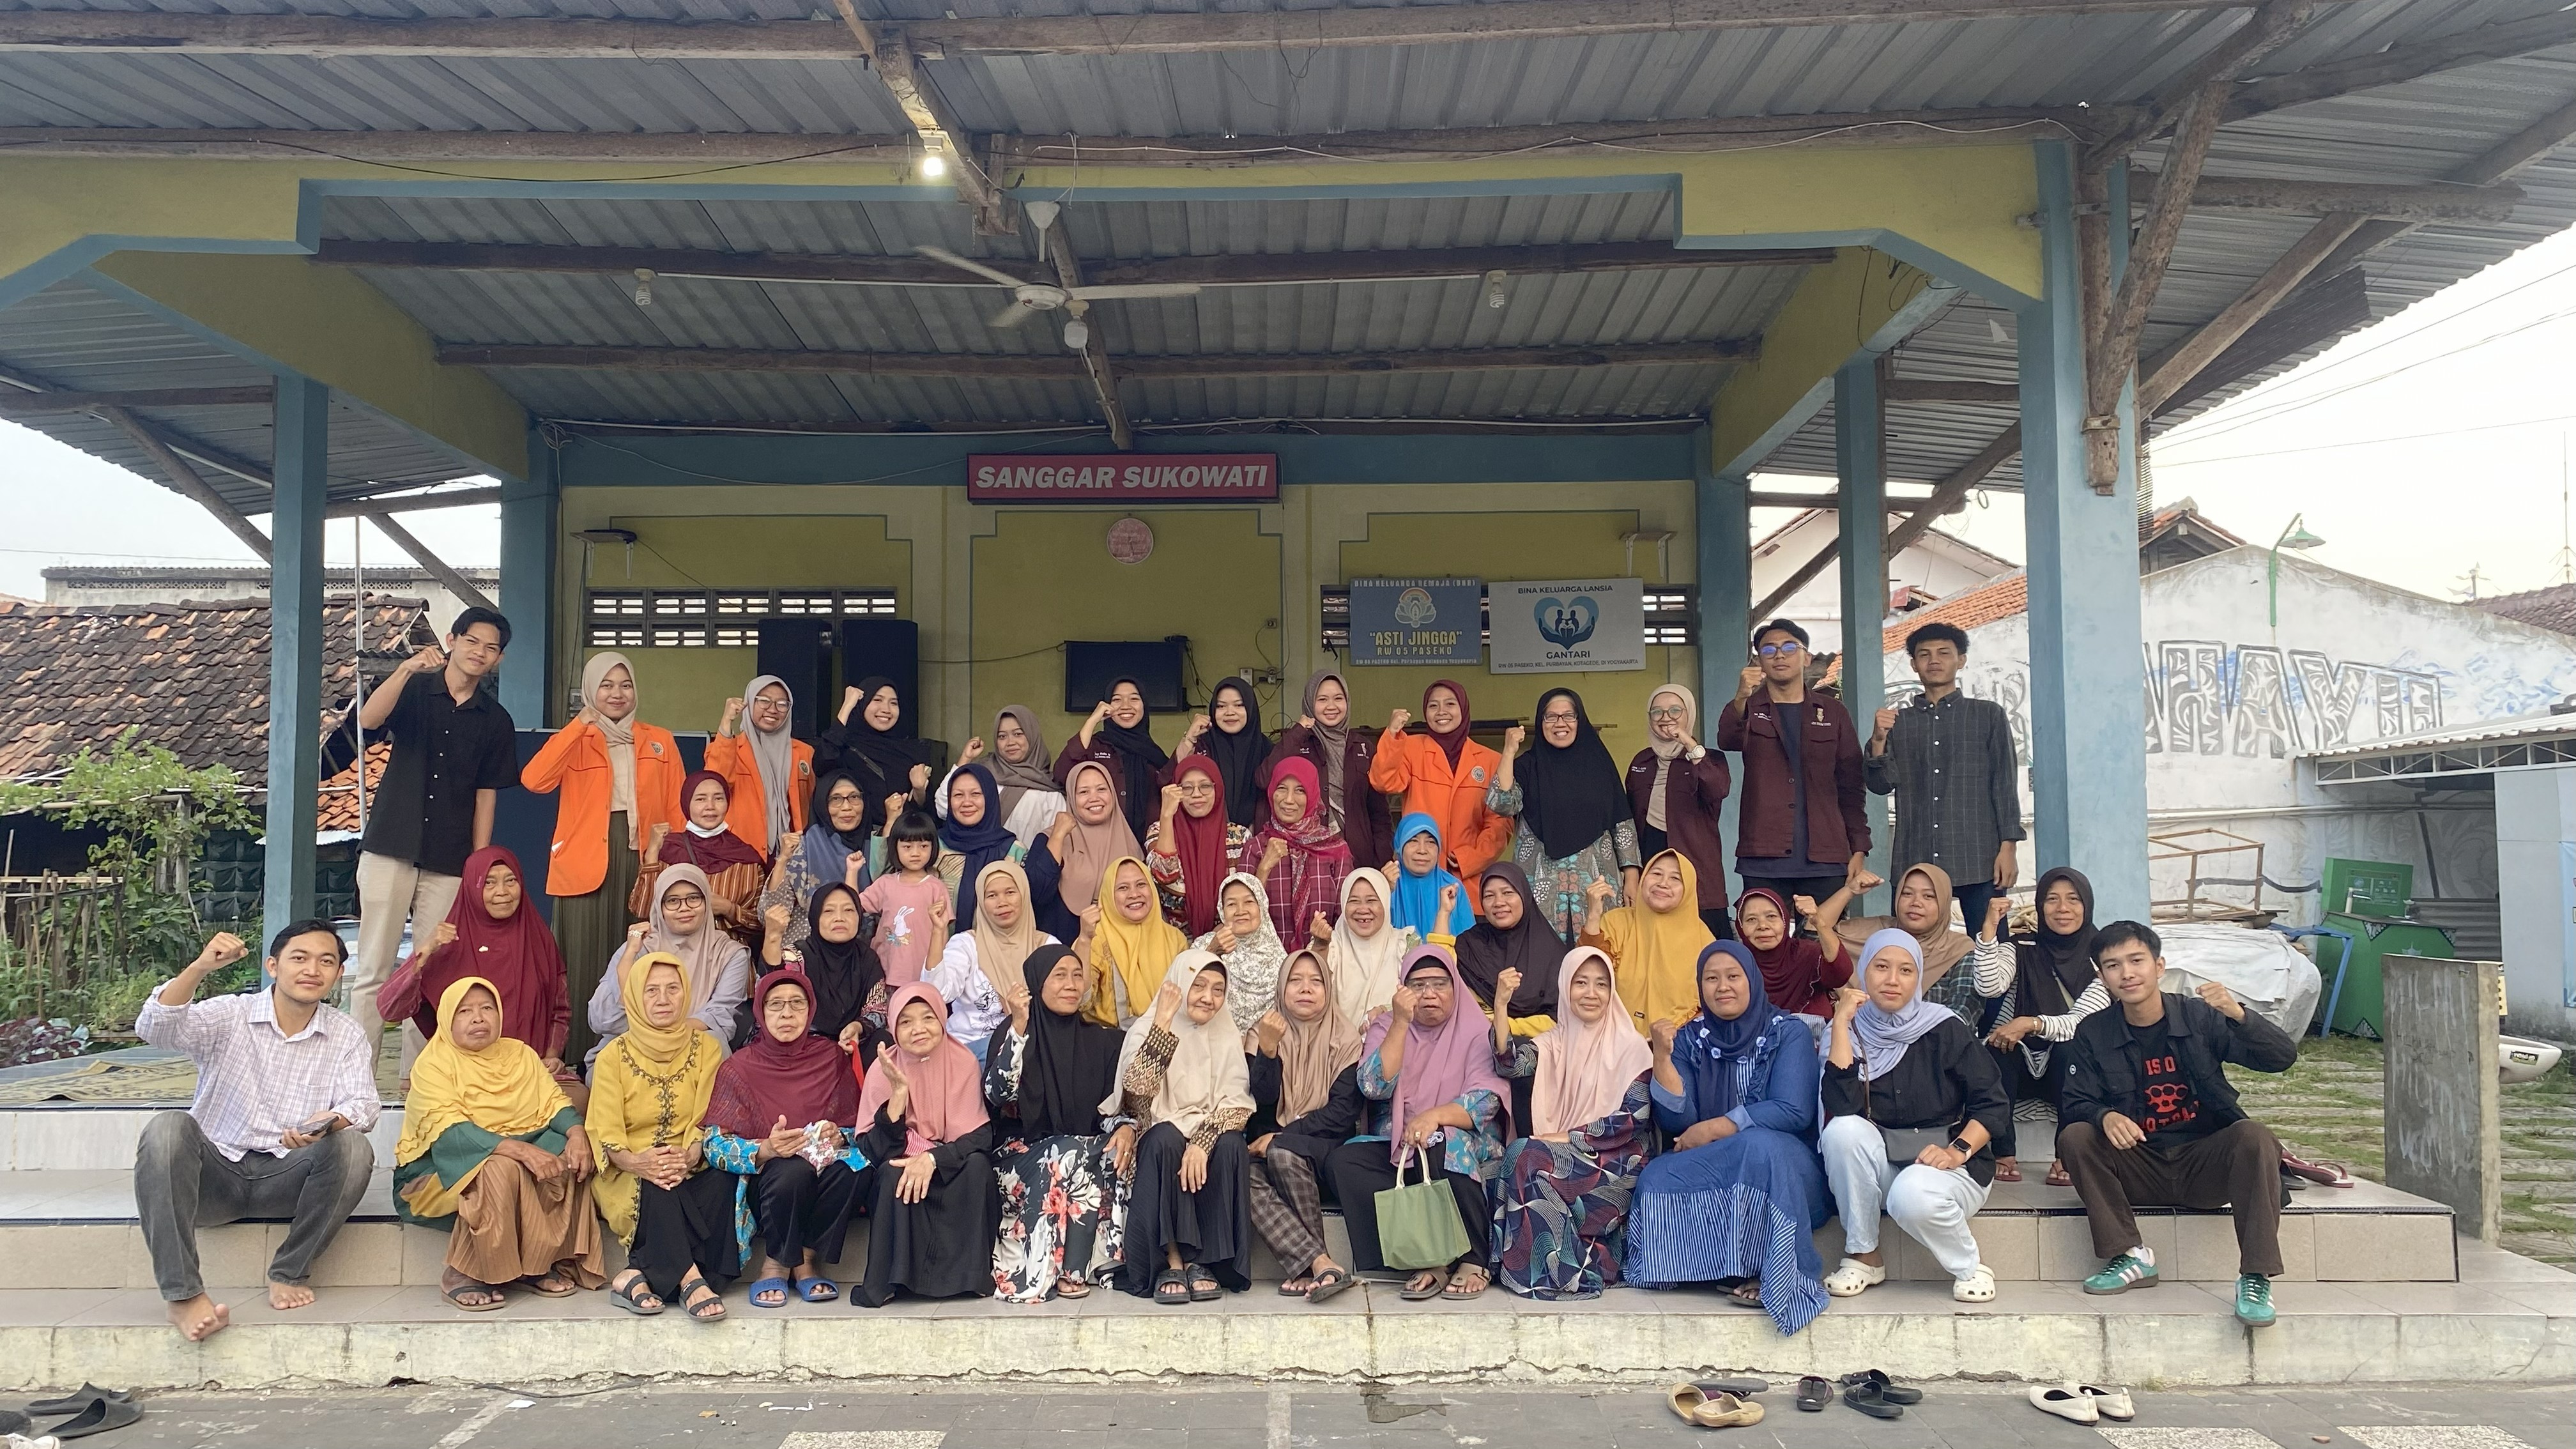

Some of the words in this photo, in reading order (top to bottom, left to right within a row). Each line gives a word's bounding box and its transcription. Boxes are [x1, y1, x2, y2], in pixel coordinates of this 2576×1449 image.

[976, 466, 1116, 488] SANGGAR
[1122, 465, 1268, 488] SUKOWATI
[1369, 631, 1403, 646] “ASTI
[1408, 631, 1462, 645] JINGGA”
[1377, 647, 1392, 656] RW
[1396, 647, 1408, 655] 05
[1413, 647, 1452, 655] PASEKO
[1546, 650, 1590, 659] GANTARI
